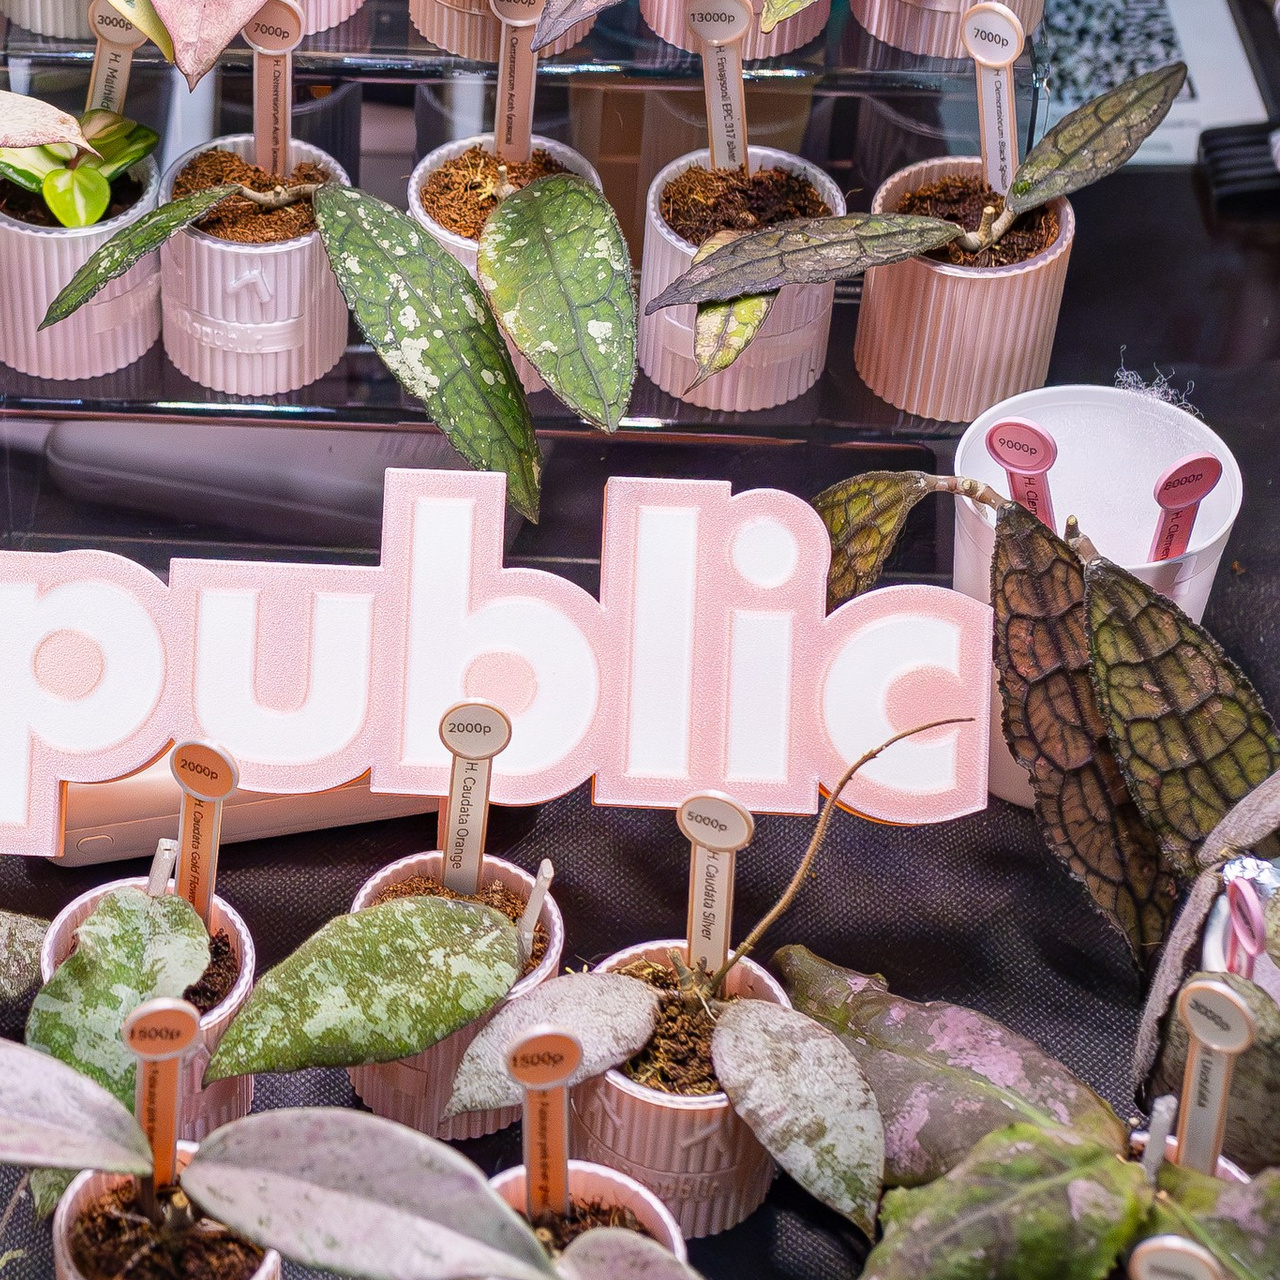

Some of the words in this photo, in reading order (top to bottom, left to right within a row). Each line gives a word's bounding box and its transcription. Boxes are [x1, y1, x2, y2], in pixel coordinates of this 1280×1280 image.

[97, 14, 133, 32] 3000p
[689, 10, 735, 23] 13000p
[253, 21, 290, 40] 7000p
[973, 28, 1009, 48] 7000p
[98, 65, 120, 111] Mathild
[721, 102, 733, 122] EPC
[724, 122, 736, 139] 317
[998, 435, 1038, 457] 9000p
[447, 721, 491, 737] 2000p
[179, 758, 219, 781] 2000p
[457, 776, 476, 826] Caudata
[189, 810, 205, 850] Caudata
[686, 810, 728, 833] 5000p
[448, 826, 470, 870] Orange
[188, 850, 202, 874] Gold
[702, 863, 719, 909] Caudata
[700, 911, 715, 942] Silver
